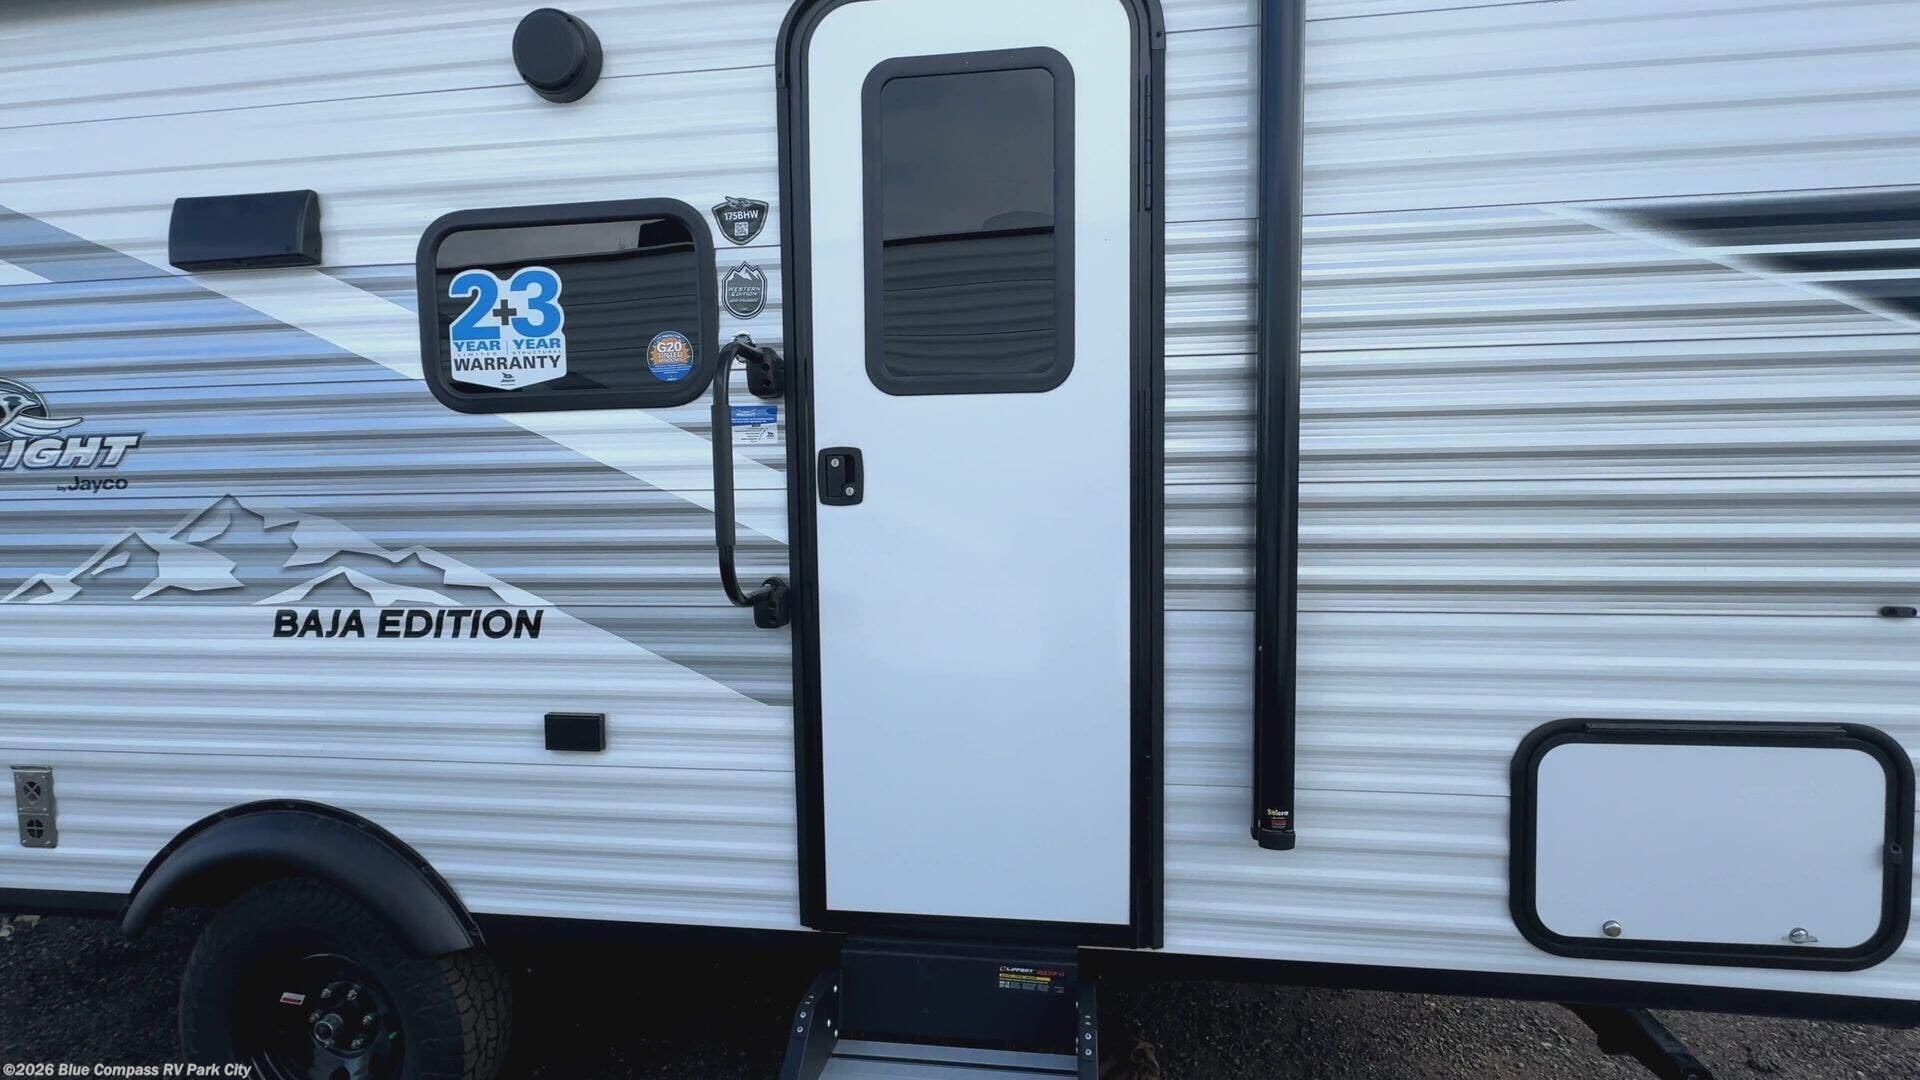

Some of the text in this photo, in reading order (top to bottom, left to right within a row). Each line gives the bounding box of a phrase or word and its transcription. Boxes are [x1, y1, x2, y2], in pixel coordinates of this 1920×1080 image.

[724, 209, 759, 221] 175BHW
[453, 340, 501, 352] YEAR
[512, 338, 561, 350] YEAR
[656, 341, 682, 353] G20
[453, 355, 561, 372] WARRANTY
[0, 435, 139, 469] IGHT
[56, 475, 128, 493] by Jayco
[273, 608, 544, 639] BAJA EDITION
